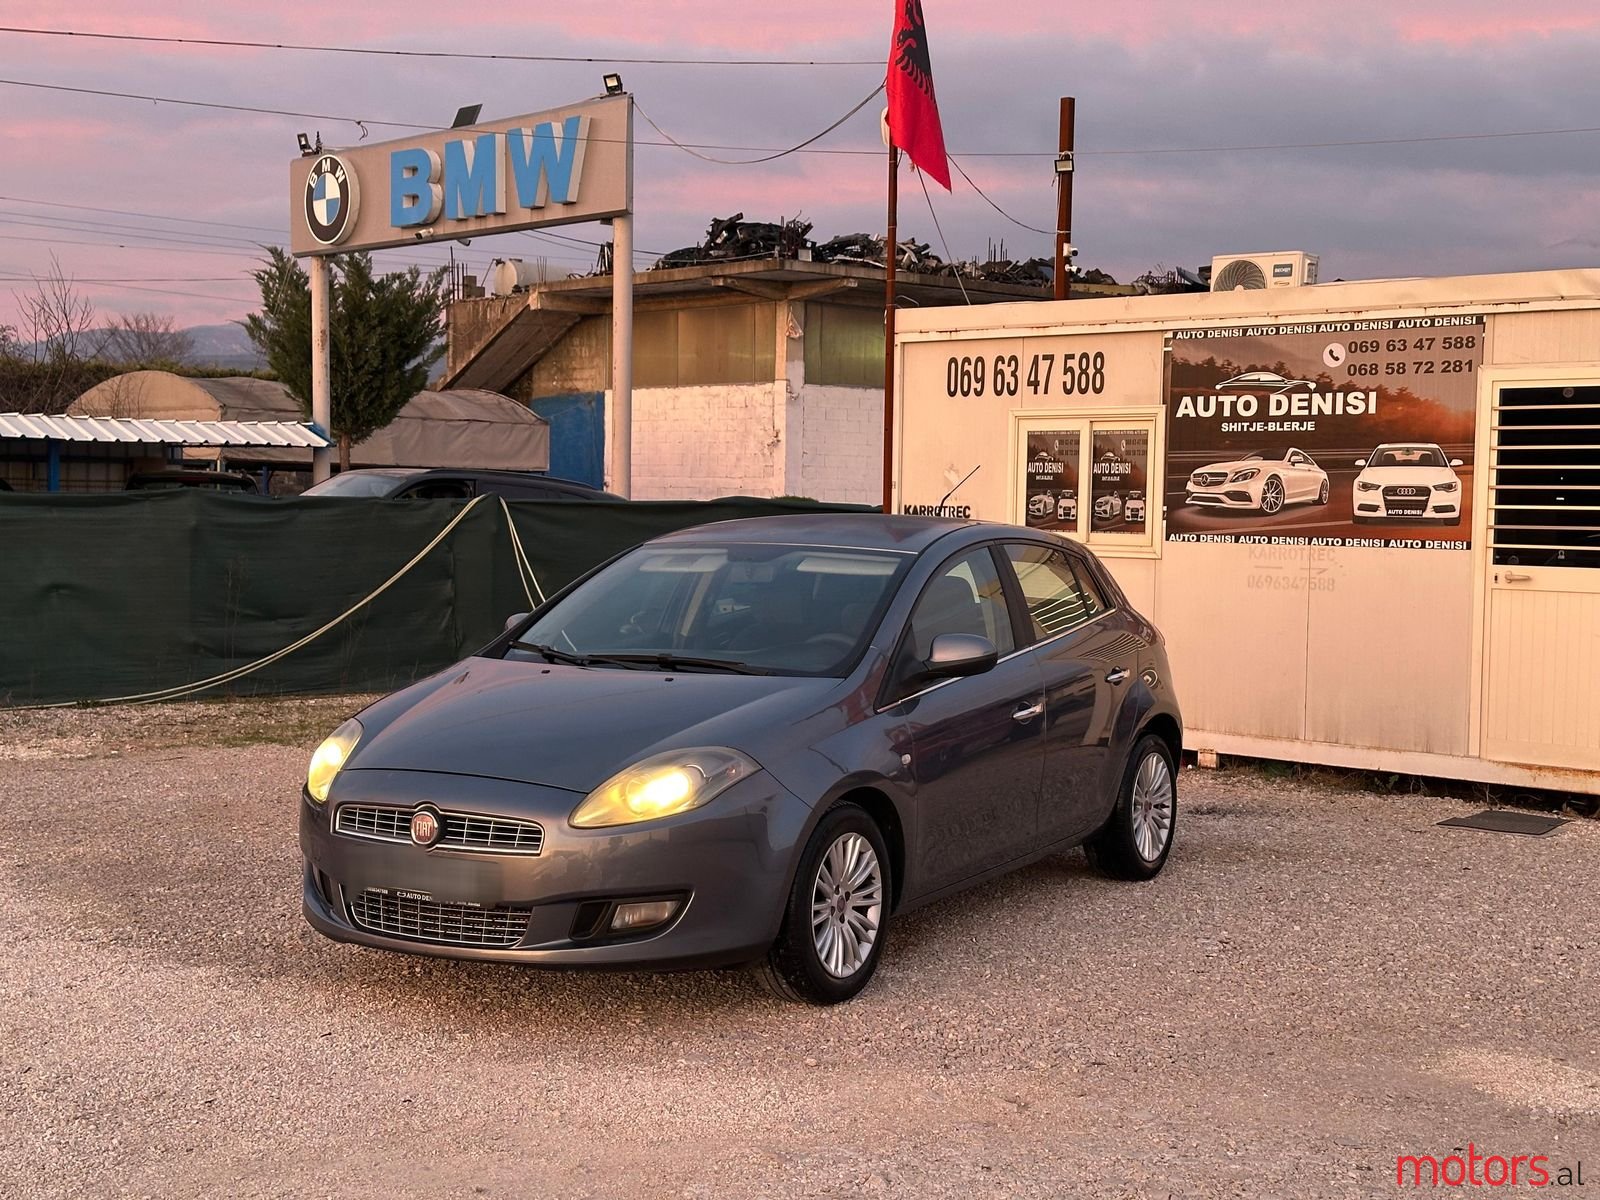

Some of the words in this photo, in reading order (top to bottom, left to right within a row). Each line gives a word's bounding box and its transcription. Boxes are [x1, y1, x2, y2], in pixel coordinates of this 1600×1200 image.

[308, 157, 347, 188] BMW
[390, 115, 592, 228] BMW
[1176, 331, 1204, 340] AUTO
[1207, 329, 1242, 338] DENISI
[1246, 326, 1276, 336] AUTO
[1279, 324, 1317, 335] DENISI
[1319, 323, 1350, 333] AUTO
[1353, 321, 1393, 331] DENISI
[1397, 318, 1431, 328] AUTO
[1434, 316, 1476, 327] DENISI
[1348, 340, 1380, 353] 069
[1386, 339, 1407, 352] 63
[1413, 338, 1436, 350] 47
[1442, 336, 1476, 350] 588
[946, 355, 985, 398] 069
[993, 354, 1019, 397] 63
[1027, 353, 1055, 395] 47
[1062, 351, 1105, 395] 588
[1347, 363, 1379, 376] 068
[1385, 362, 1406, 375] 58
[1413, 361, 1434, 374] 72
[1440, 359, 1473, 373] 281
[1175, 394, 1258, 418] AUTO
[1269, 391, 1377, 417] DENISI
[1221, 421, 1316, 432] SHITJE-BLERJE
[1028, 462, 1043, 473] AUTO
[1093, 462, 1110, 474] AUTO
[903, 504, 971, 519] KARROTREC
[1168, 533, 1197, 543] AUTO
[1200, 534, 1235, 543] DENISI
[1239, 535, 1268, 544] AUTO
[1271, 536, 1308, 545] DENISI
[1310, 537, 1342, 546] AUTO
[1345, 538, 1384, 547] DENISI
[1389, 539, 1422, 549] AUTO
[1425, 540, 1467, 550] DENISI
[1248, 545, 1336, 561] KARROTREC
[1247, 575, 1336, 592] 0696347588
[416, 821, 431, 837] FIAT
